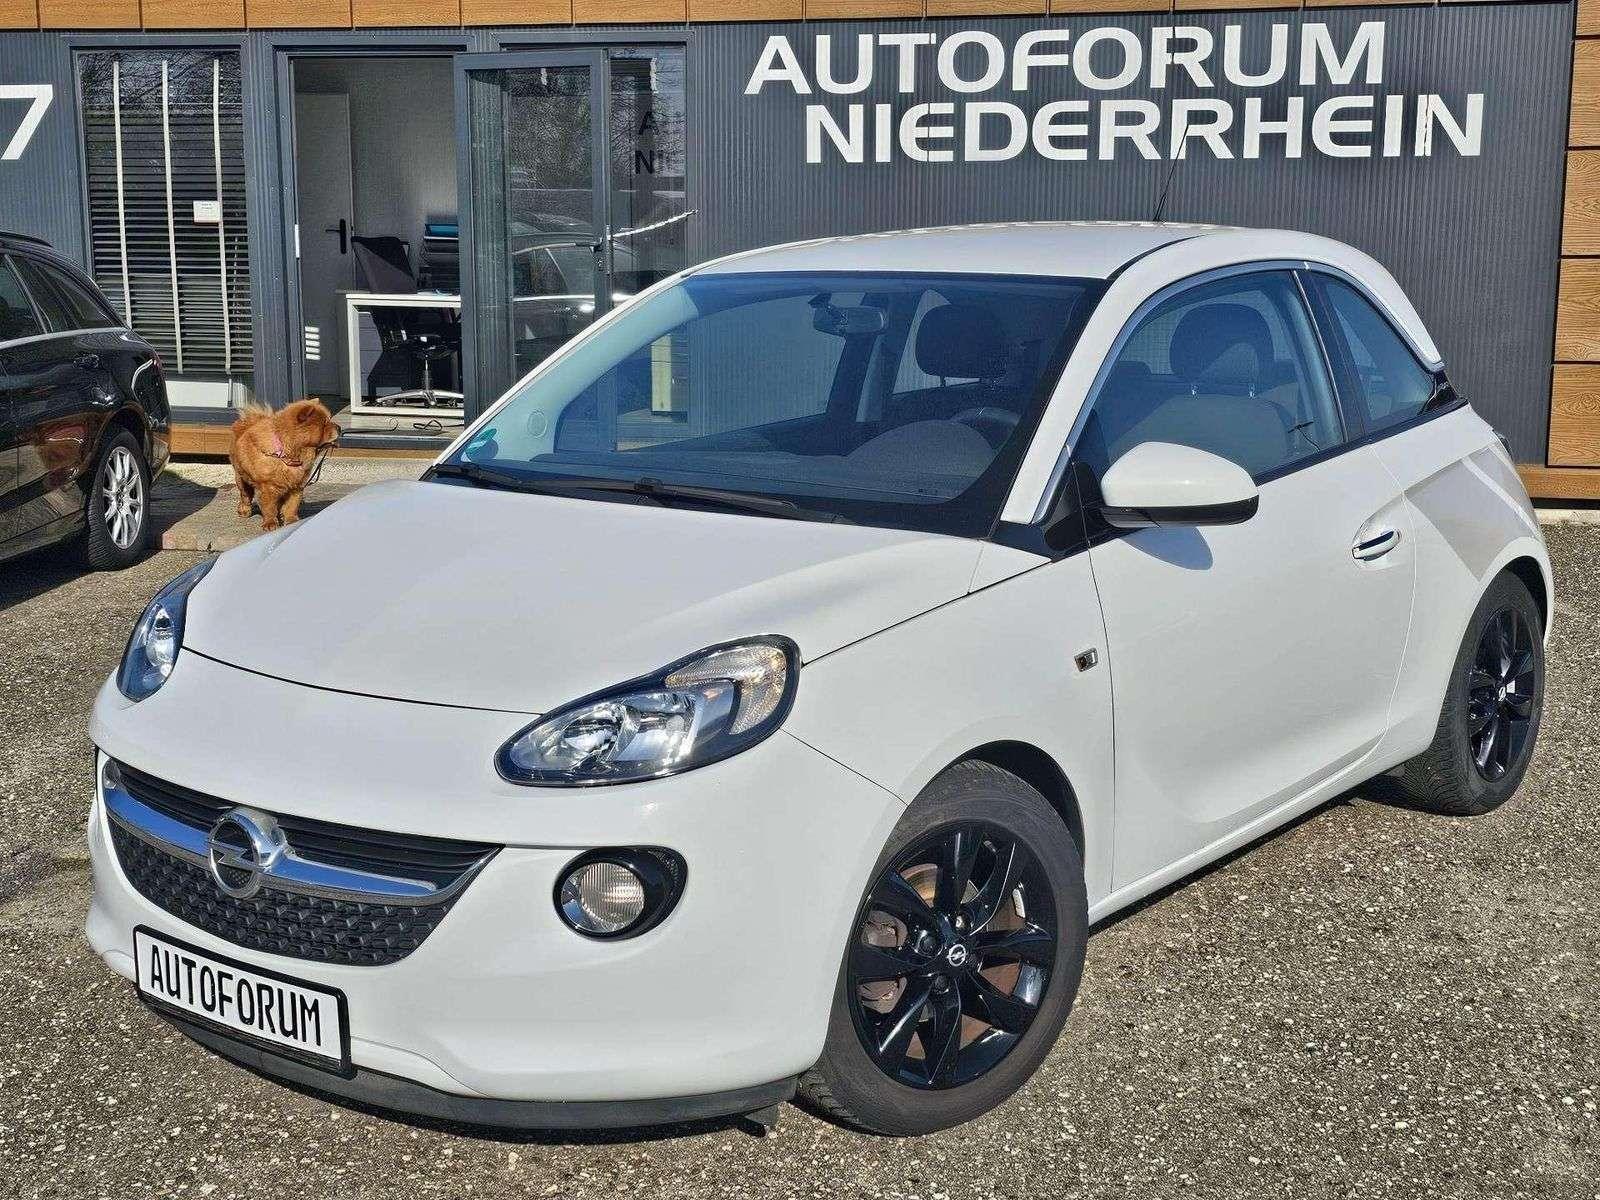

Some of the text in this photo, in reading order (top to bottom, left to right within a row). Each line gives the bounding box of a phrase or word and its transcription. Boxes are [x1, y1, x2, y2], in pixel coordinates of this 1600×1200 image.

[744, 21, 1386, 95] AUTOFORUM
[0, 84, 53, 160] 7
[805, 93, 1484, 163] NIEDERRHEIN
[151, 945, 321, 1046] AUTOFORUM
